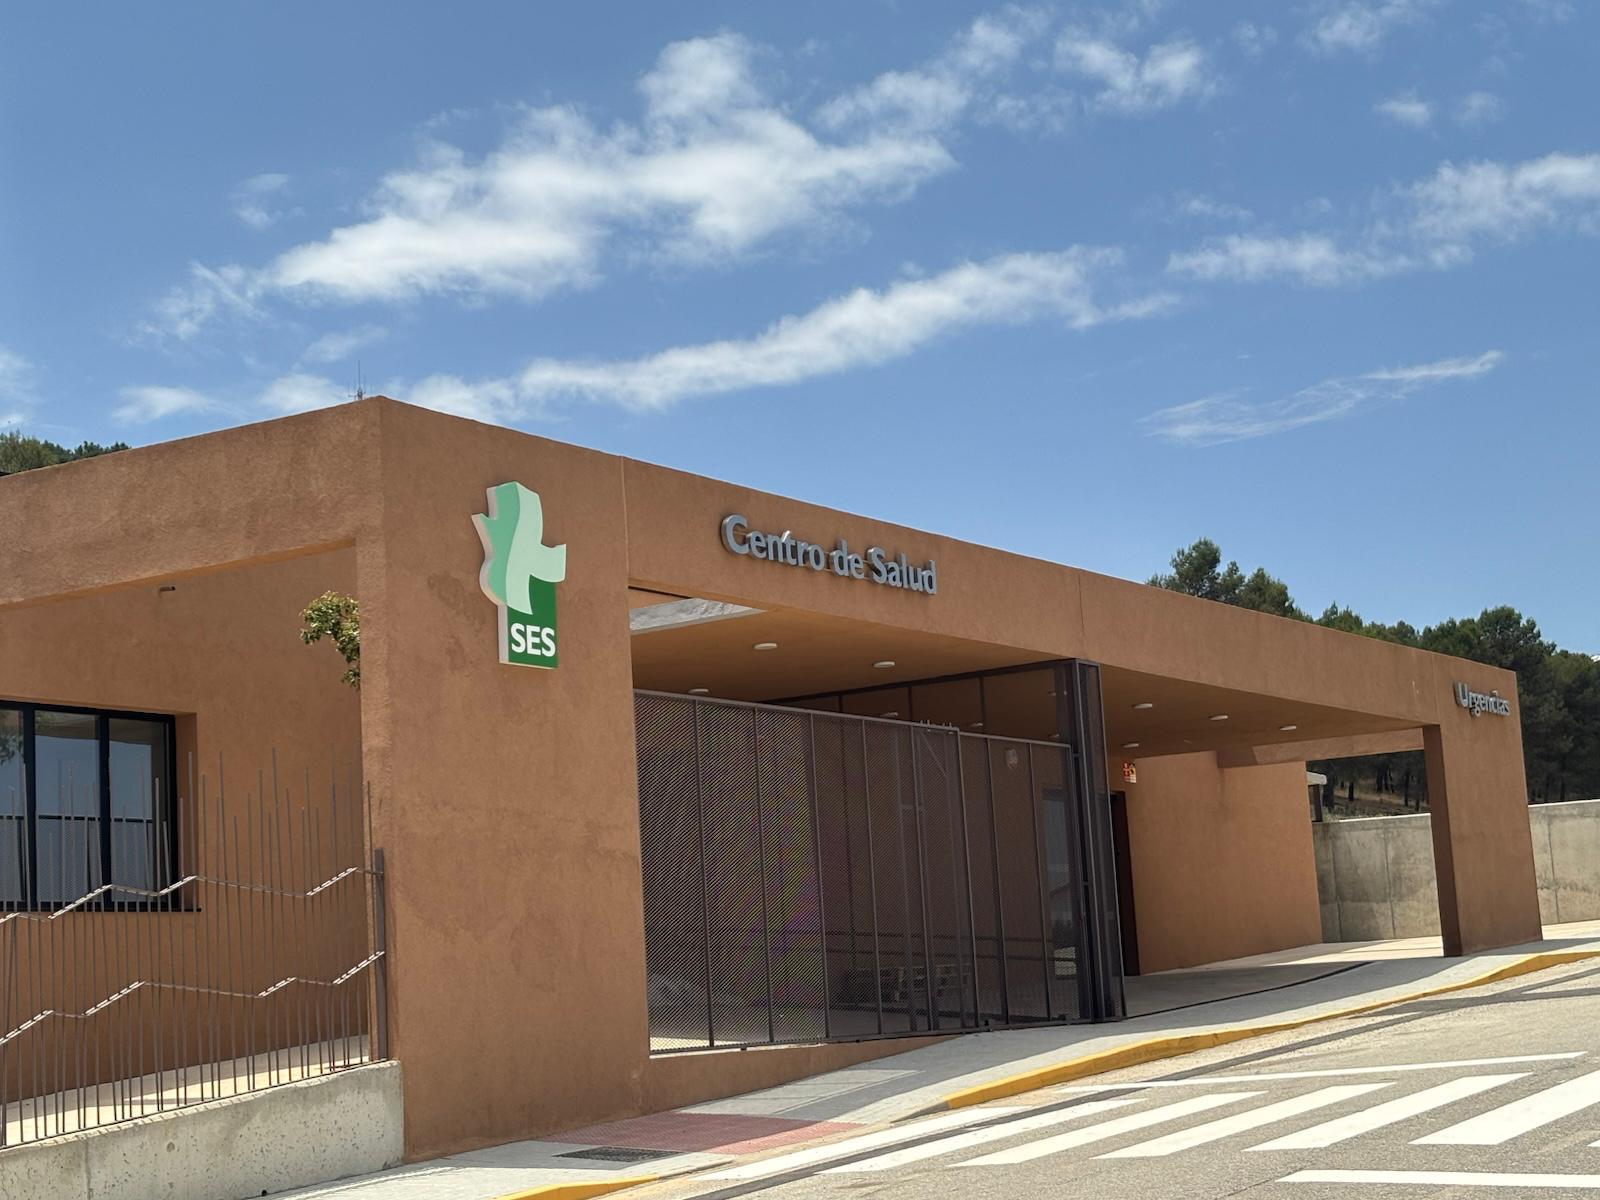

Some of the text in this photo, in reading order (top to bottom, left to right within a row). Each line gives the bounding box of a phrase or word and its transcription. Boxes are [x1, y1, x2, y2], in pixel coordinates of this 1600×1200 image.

[721, 514, 937, 595] Centro de Salud
[510, 622, 556, 657] SES
[1456, 682, 1510, 717] Urgencias
